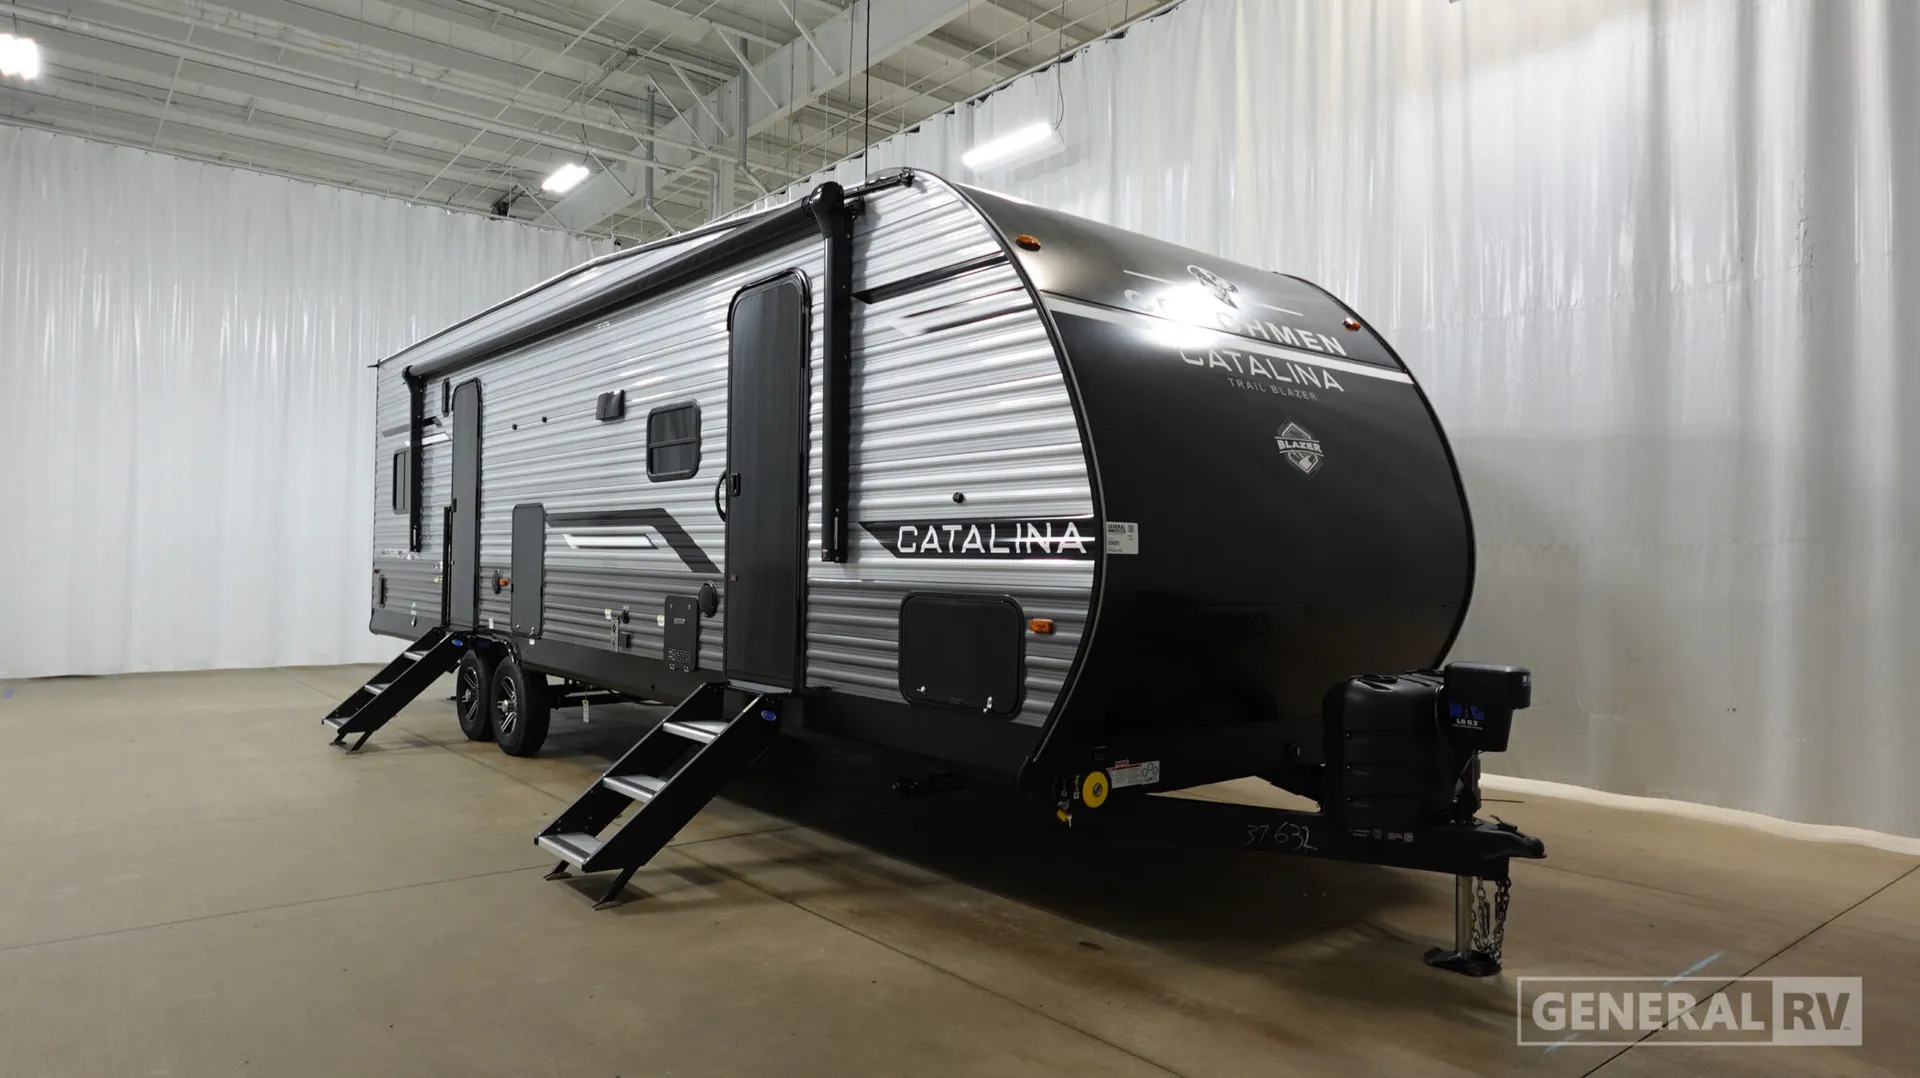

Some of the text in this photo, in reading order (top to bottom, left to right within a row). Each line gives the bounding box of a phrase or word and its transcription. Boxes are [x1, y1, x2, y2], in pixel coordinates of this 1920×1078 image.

[1228, 377, 1317, 402] TRAIL BLAZER
[1277, 439, 1322, 453] BLAZER
[897, 521, 1087, 554] CATALINA
